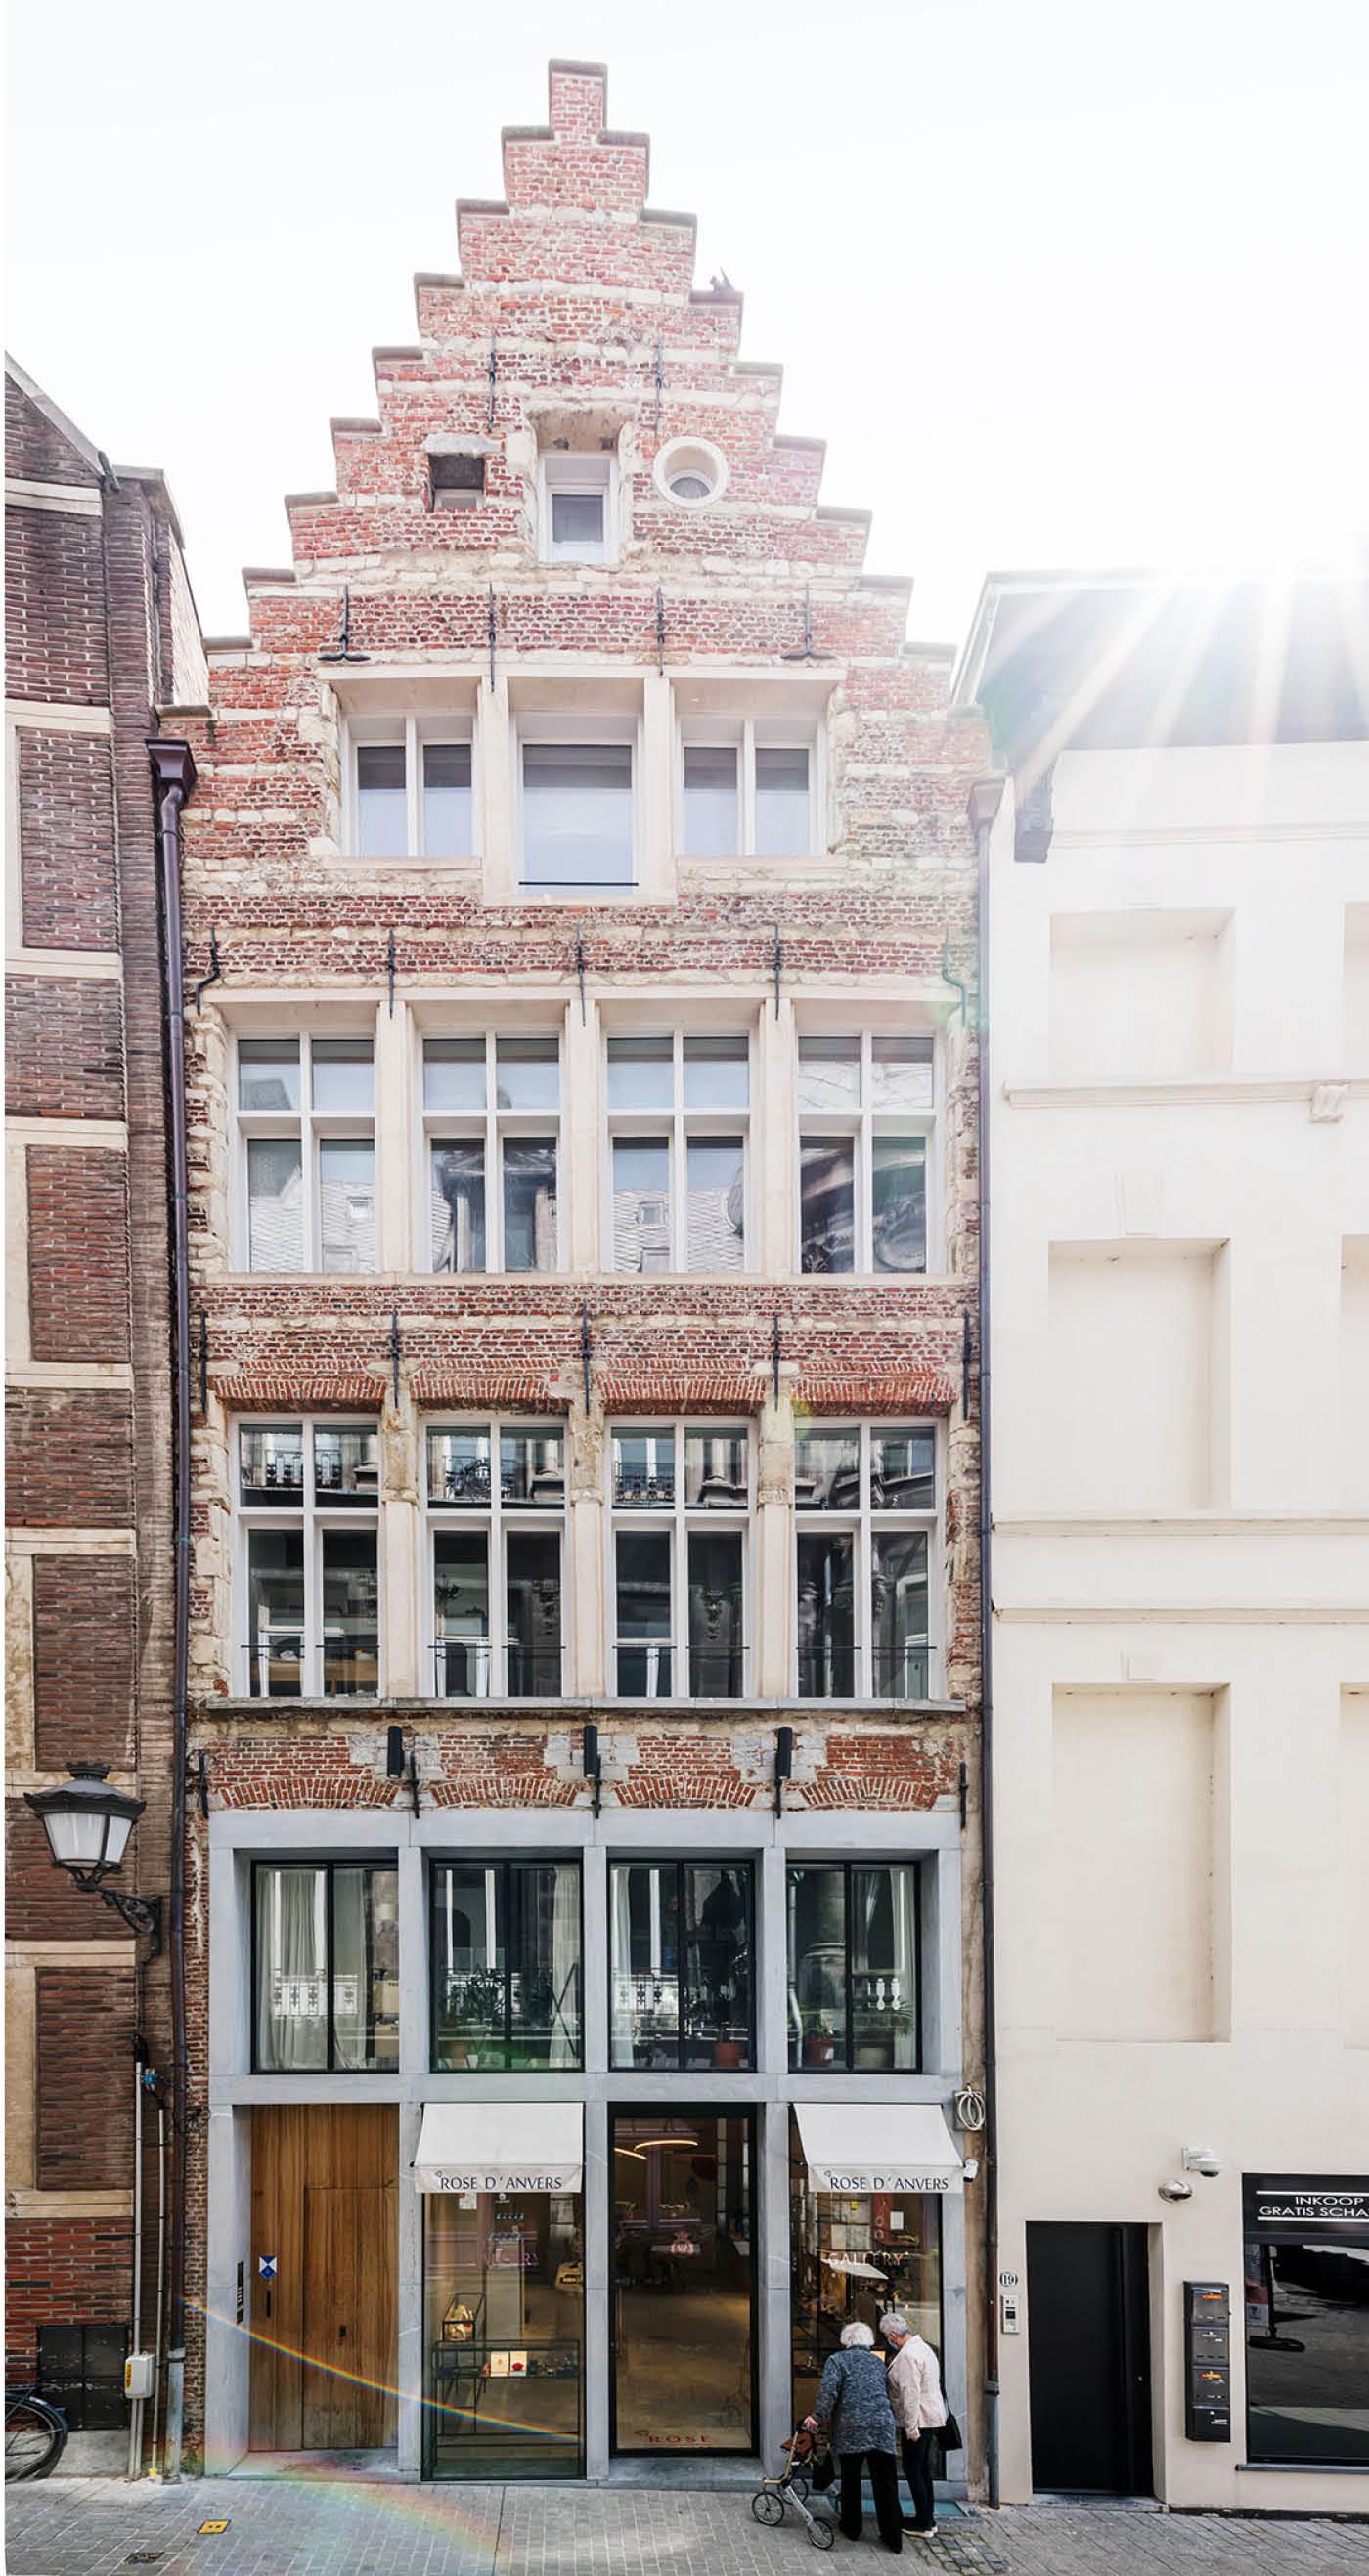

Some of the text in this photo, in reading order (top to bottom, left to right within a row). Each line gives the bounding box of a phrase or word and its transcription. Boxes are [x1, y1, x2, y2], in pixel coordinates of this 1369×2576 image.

[440, 2176, 478, 2190] ROSE
[830, 2176, 867, 2190] ROSE
[1295, 2196, 1364, 2206] INKOOP
[1259, 2205, 1369, 2217] GRATIS SCHA
[828, 2251, 904, 2265] GALLERY
[1003, 2274, 1015, 2285] 19
